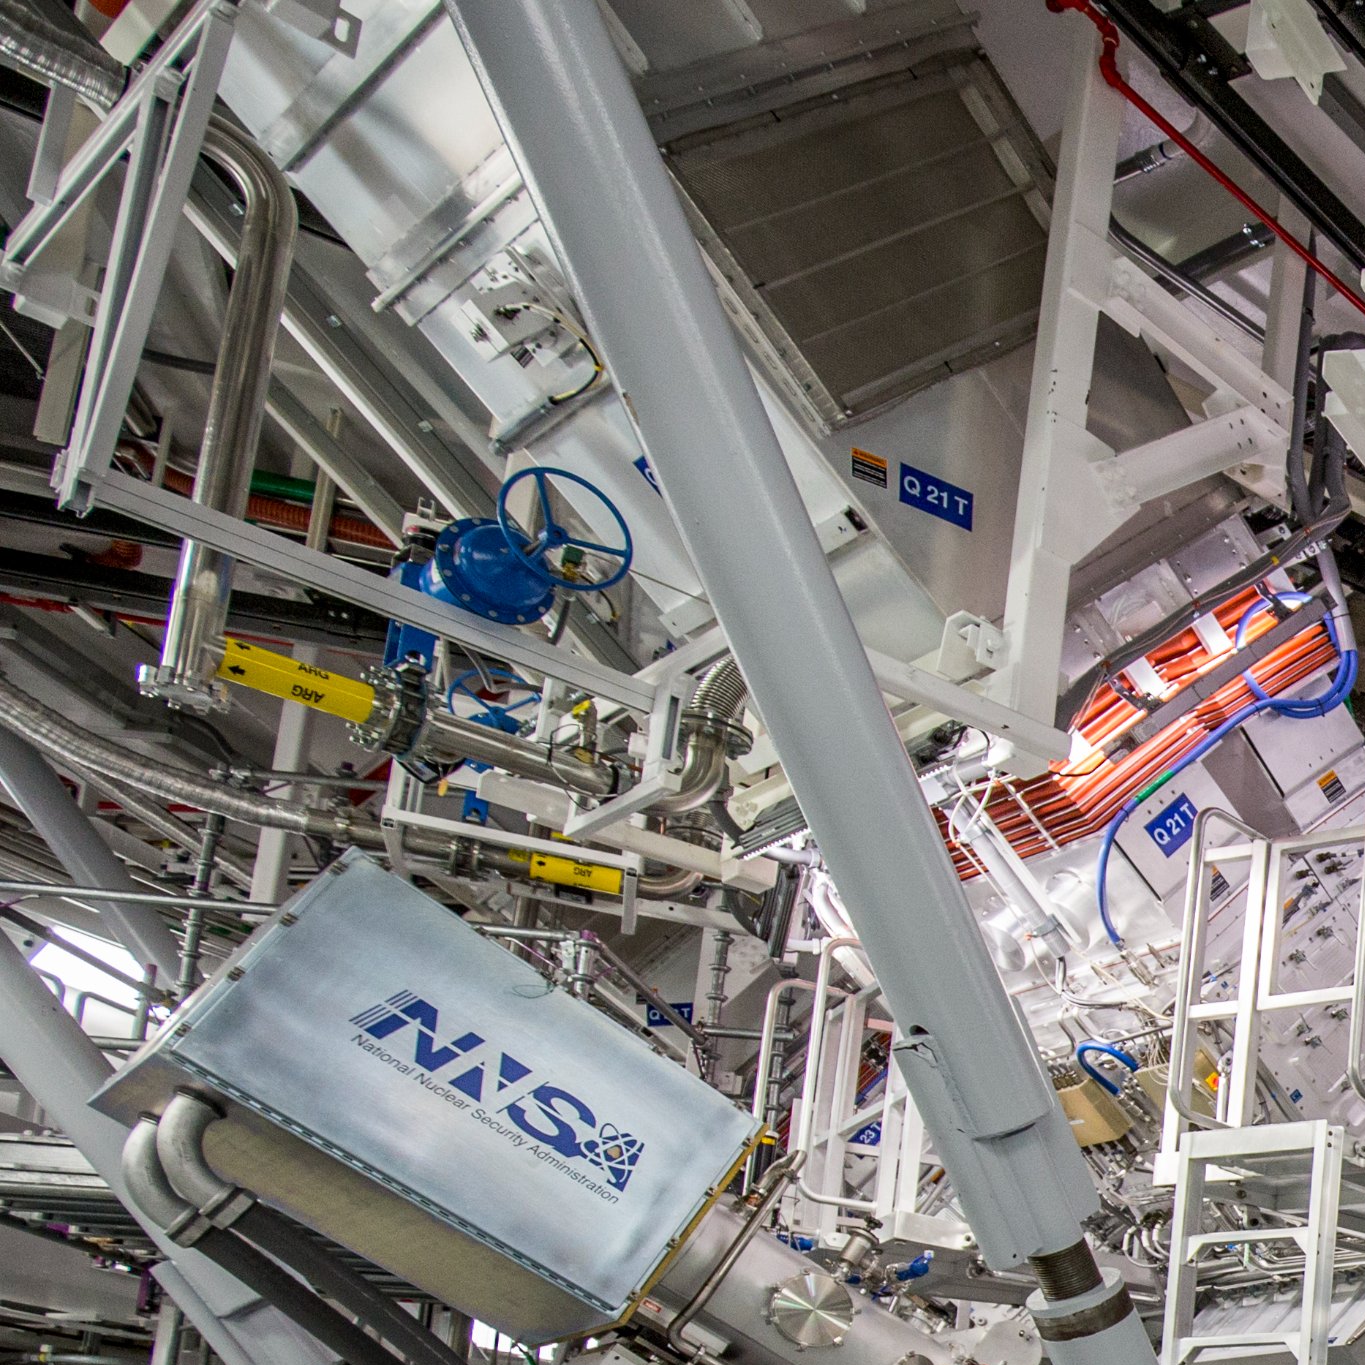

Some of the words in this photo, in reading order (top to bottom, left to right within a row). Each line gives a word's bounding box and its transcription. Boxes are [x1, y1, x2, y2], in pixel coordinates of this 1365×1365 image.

[291, 684, 325, 704] ARG
[573, 866, 593, 878] ARG
[350, 1033, 413, 1076] National
[413, 1072, 472, 1112] Nuclear
[471, 1107, 528, 1148] Security
[527, 1145, 619, 1205] Administration
